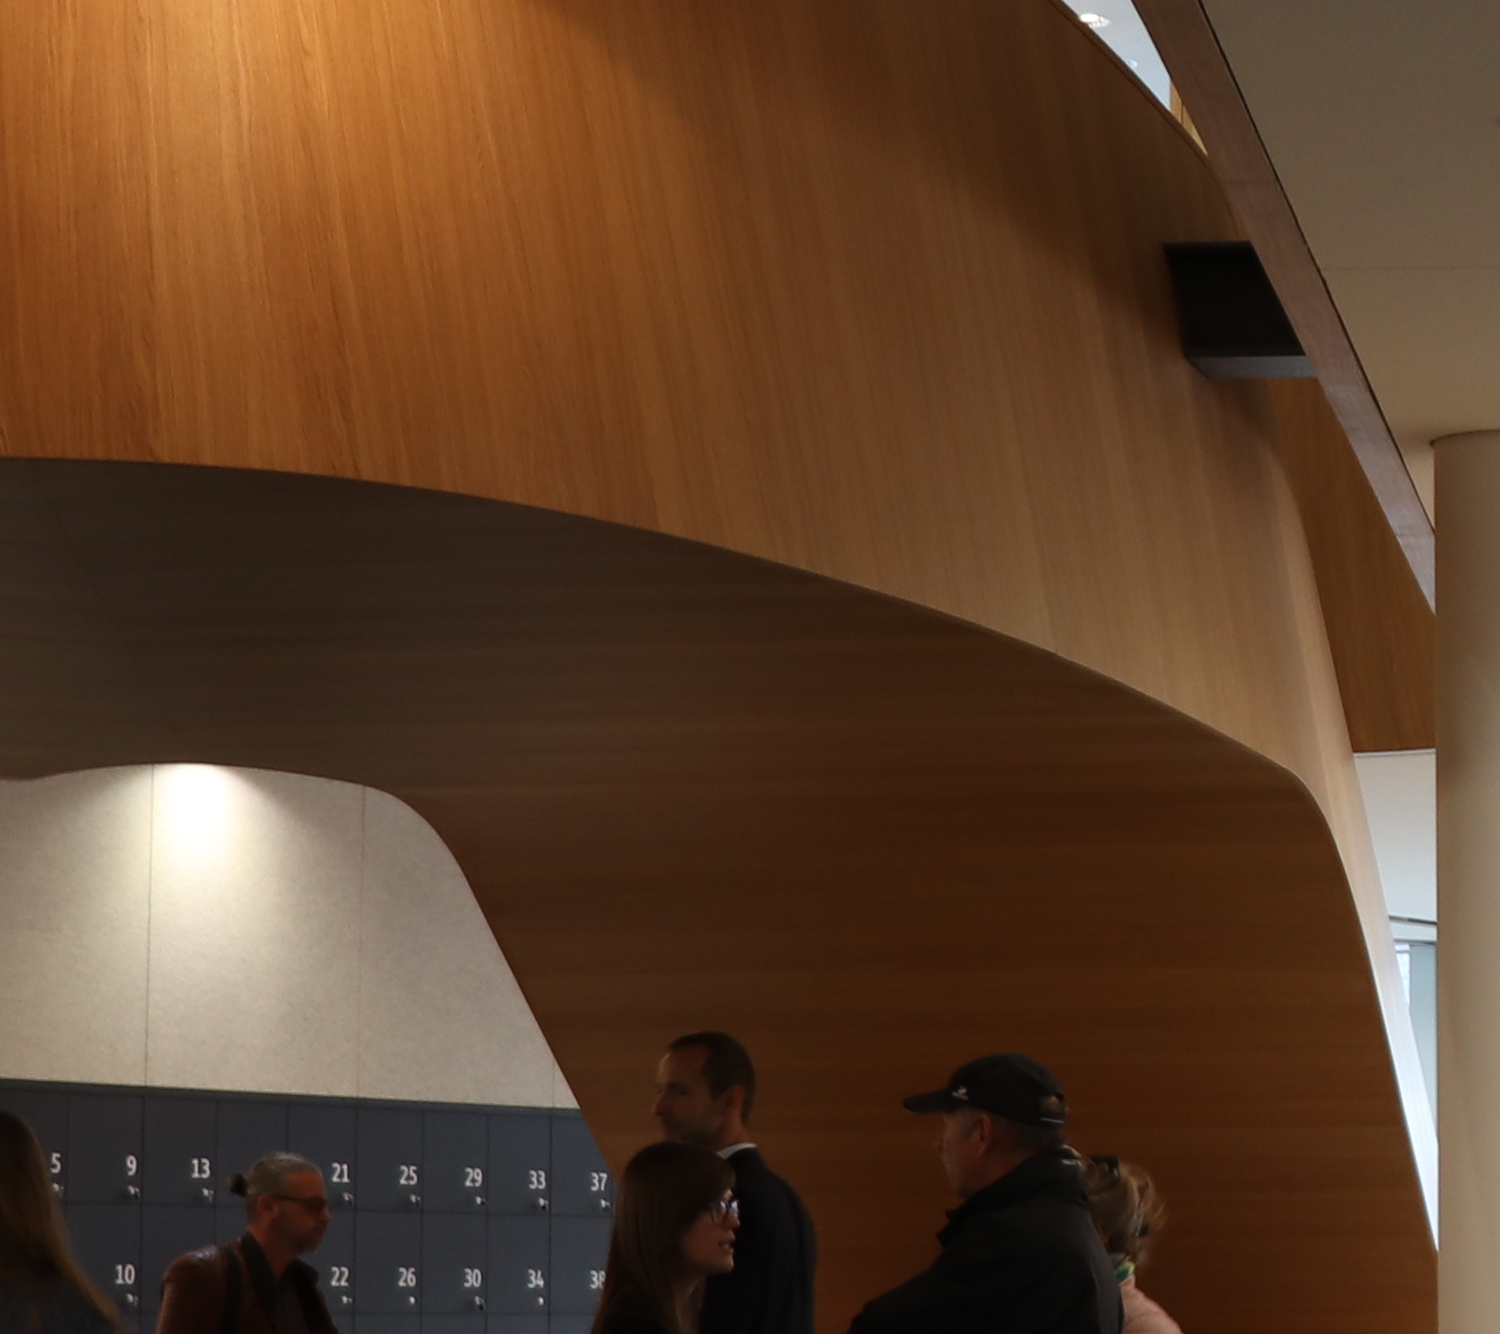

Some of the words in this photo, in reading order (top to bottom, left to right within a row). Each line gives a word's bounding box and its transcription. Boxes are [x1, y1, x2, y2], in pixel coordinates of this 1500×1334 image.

[50, 1152, 62, 1174] 5
[126, 1154, 138, 1176] 9
[191, 1157, 211, 1179] 13
[332, 1162, 350, 1183] 21
[400, 1165, 418, 1185] 25
[465, 1167, 483, 1187] 29
[529, 1170, 546, 1190] 33
[591, 1172, 608, 1191] 37
[114, 1264, 136, 1285] 10
[330, 1266, 349, 1287] 22
[399, 1267, 417, 1287] 26
[463, 1268, 482, 1288] 30
[527, 1269, 545, 1289] 34
[590, 1270, 606, 1290] 38
